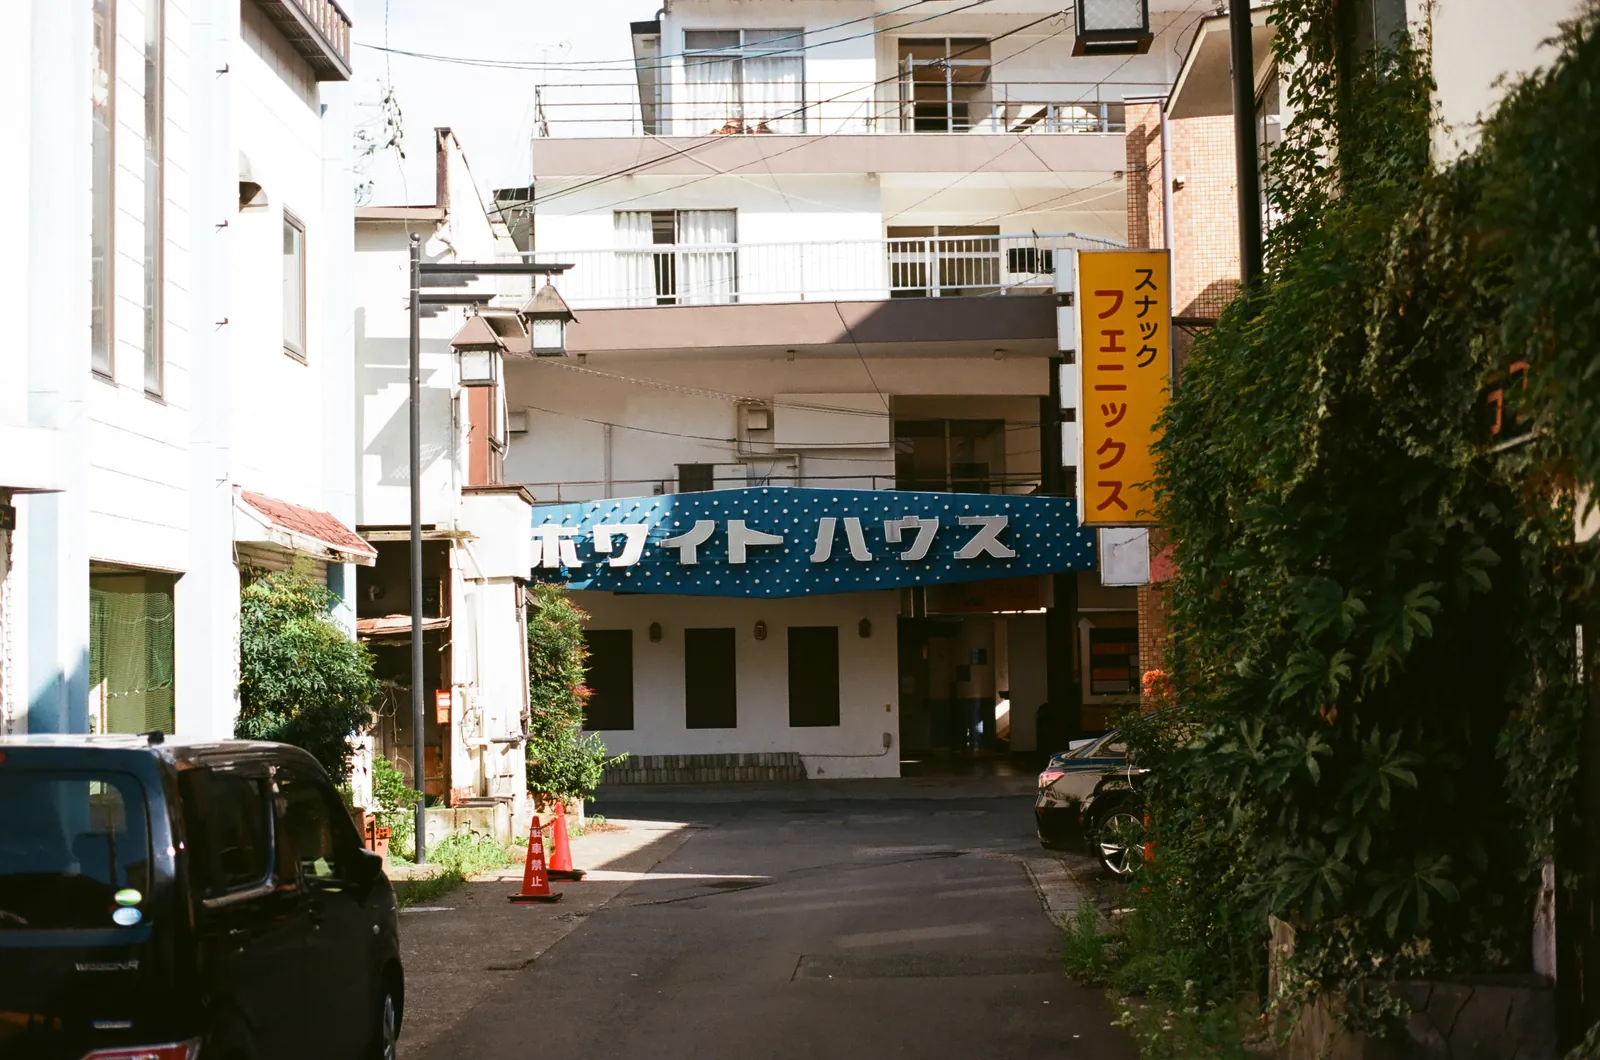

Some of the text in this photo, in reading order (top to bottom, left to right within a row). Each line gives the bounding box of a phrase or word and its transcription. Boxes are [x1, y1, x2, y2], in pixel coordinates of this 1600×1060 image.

[1134, 268, 1159, 368] スナック
[1093, 289, 1129, 512] フェニックス
[531, 515, 1017, 569] ホワイトハウス
[530, 827, 543, 887] 駐車禁止
